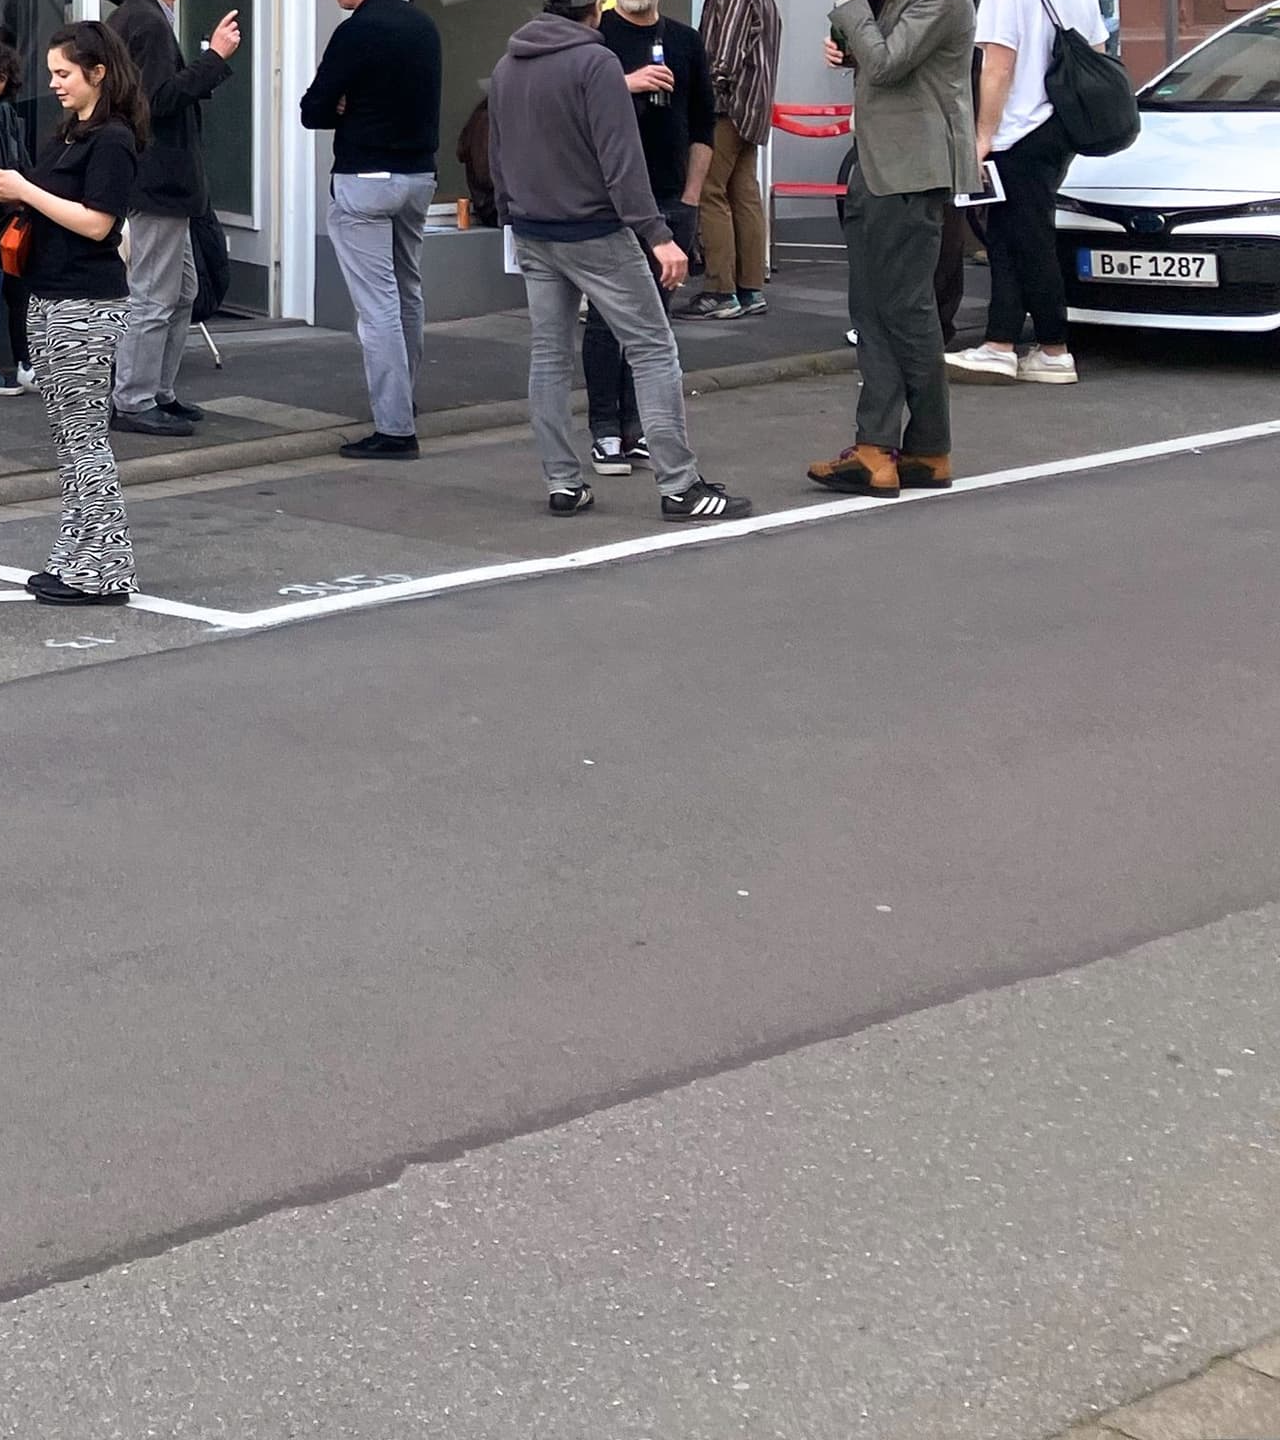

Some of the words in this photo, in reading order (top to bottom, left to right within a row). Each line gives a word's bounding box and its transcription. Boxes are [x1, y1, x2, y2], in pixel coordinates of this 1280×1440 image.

[1100, 254, 1115, 275] B
[1129, 255, 1143, 276] F
[1148, 256, 1206, 278] 1287
